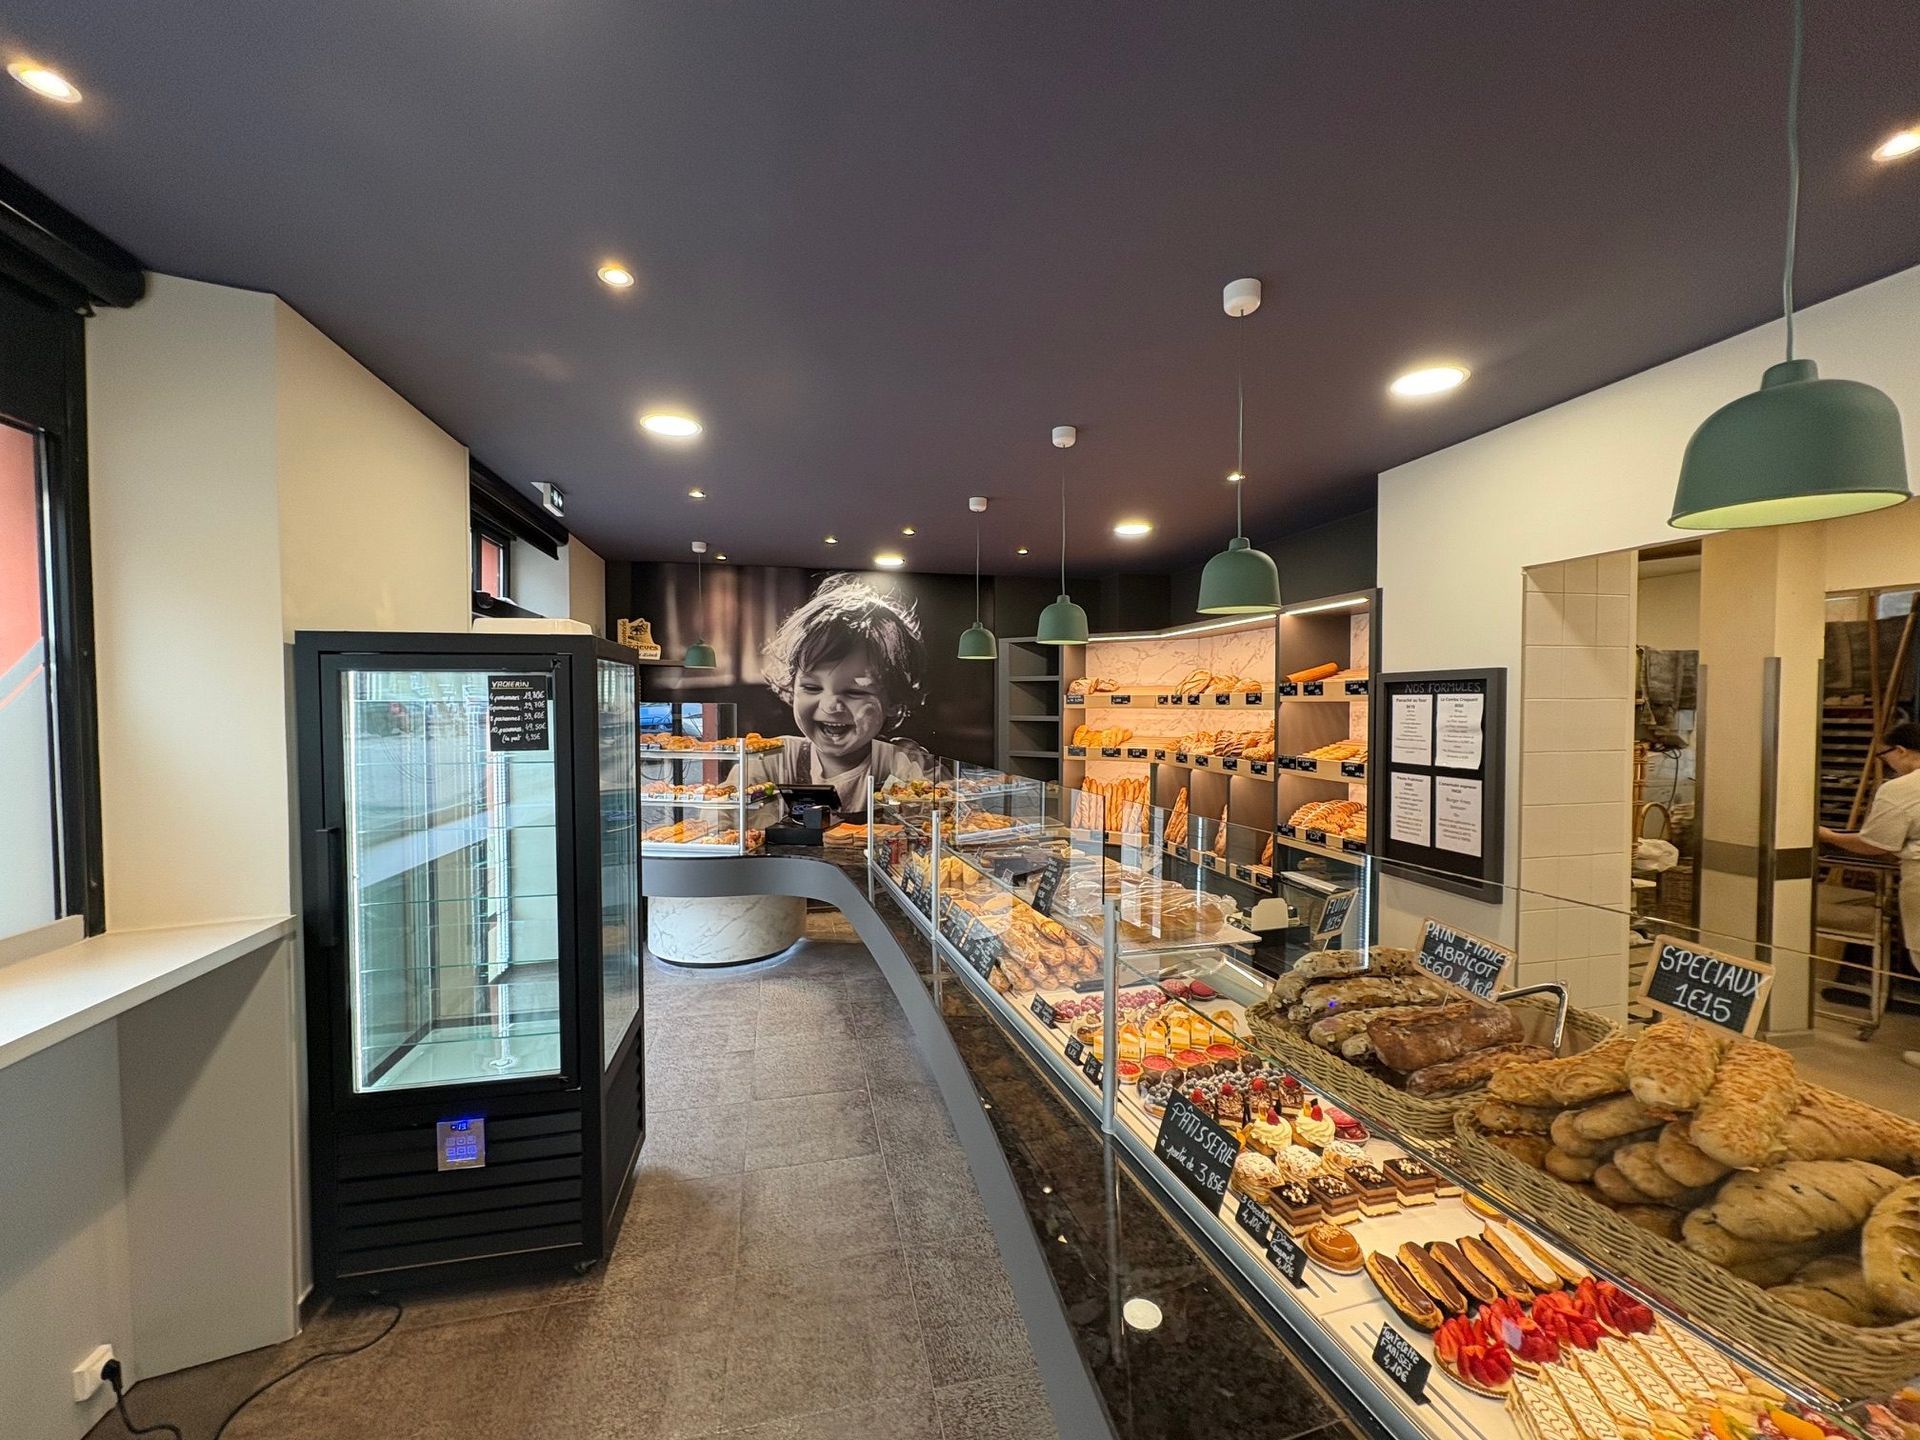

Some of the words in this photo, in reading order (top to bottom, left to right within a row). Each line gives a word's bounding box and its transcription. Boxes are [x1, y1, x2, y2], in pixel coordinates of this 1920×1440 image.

[1404, 683, 1425, 693] NOS
[1428, 682, 1480, 693] FORMULES
[1425, 920, 1457, 943] PAIN
[1464, 937, 1512, 969] FIGUES
[1434, 943, 1499, 977] ABRICOT
[1418, 951, 1453, 979] 5€60
[1456, 971, 1470, 989] le
[1660, 945, 1772, 1000] SPECIAUX
[1170, 1102, 1237, 1168] PÂTISSERIE
[1185, 1157, 1195, 1171] de
[1195, 1163, 1226, 1195] 3,85€
[1240, 1194, 1248, 1203] 3
[1242, 1209, 1263, 1232] 4,10€
[1275, 1257, 1295, 1278] 4,10€
[1380, 1338, 1413, 1371] FRAISES
[1383, 1353, 1410, 1383] 4,10€
